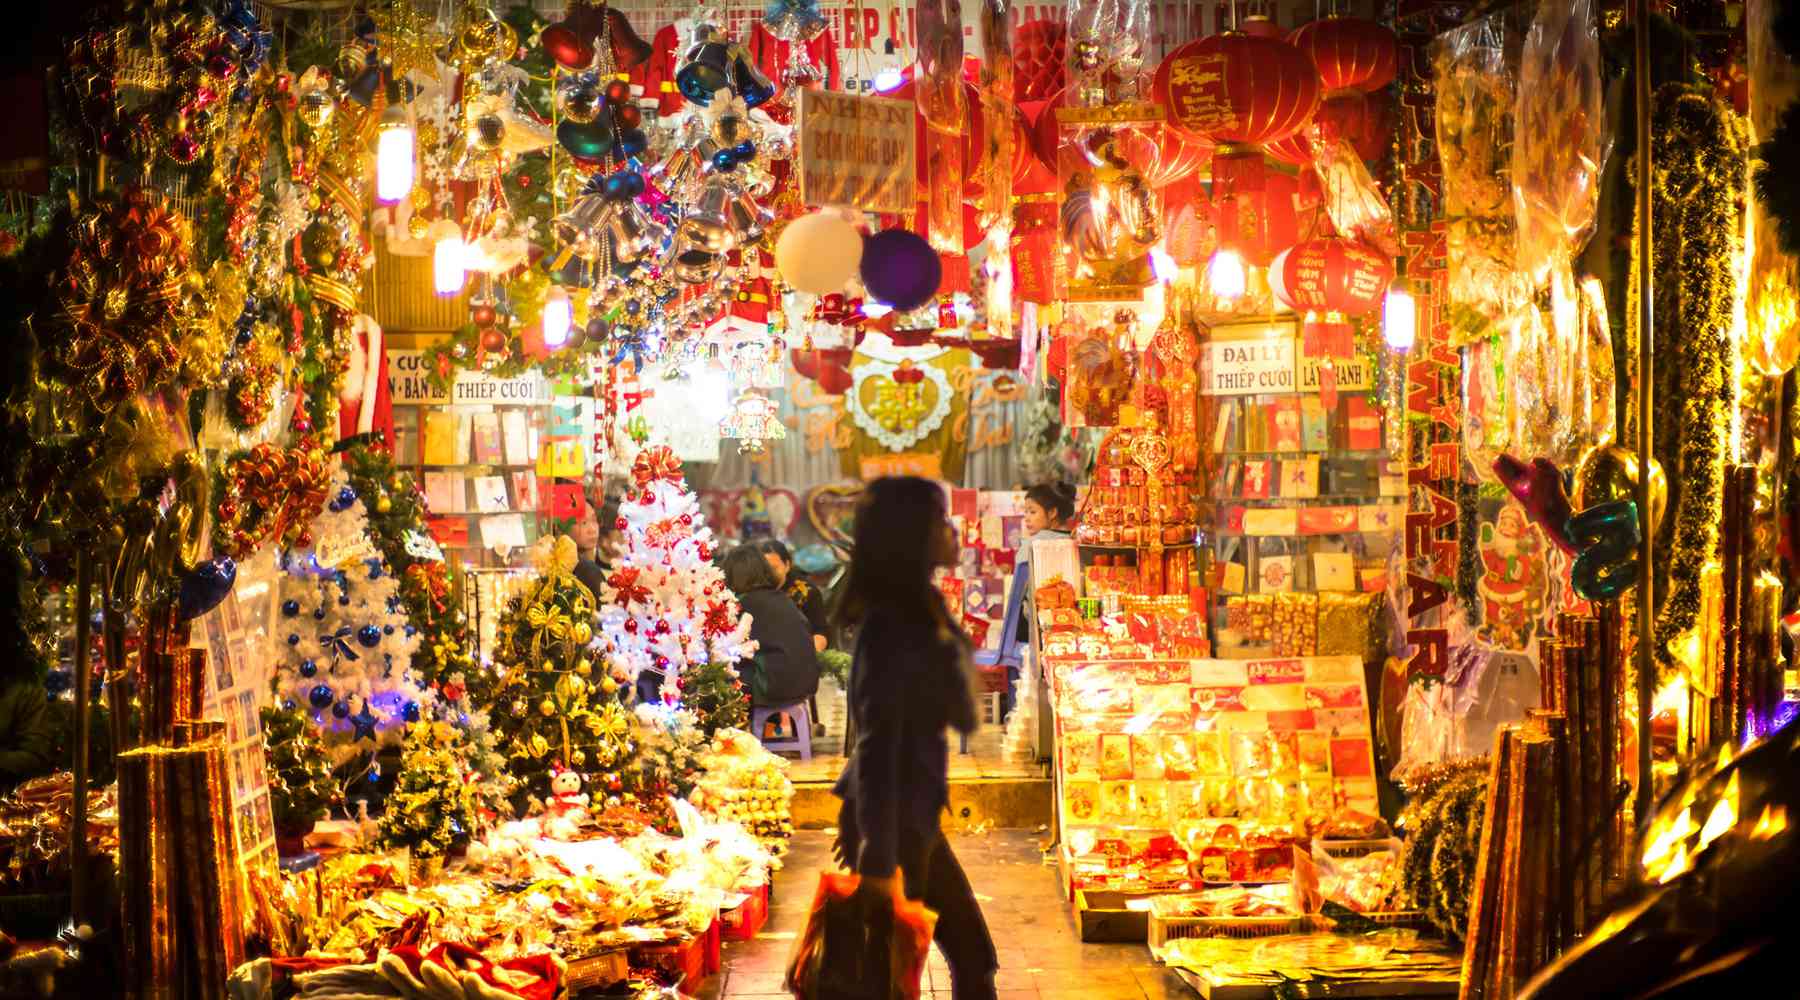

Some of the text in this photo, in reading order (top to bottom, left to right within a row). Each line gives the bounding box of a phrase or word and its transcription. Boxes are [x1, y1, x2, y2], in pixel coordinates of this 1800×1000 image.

[404, 371, 428, 399] BÁN
[456, 369, 534, 399] THIẾP CƯỚI
[1216, 365, 1293, 389] THIẾP CƯỚI
